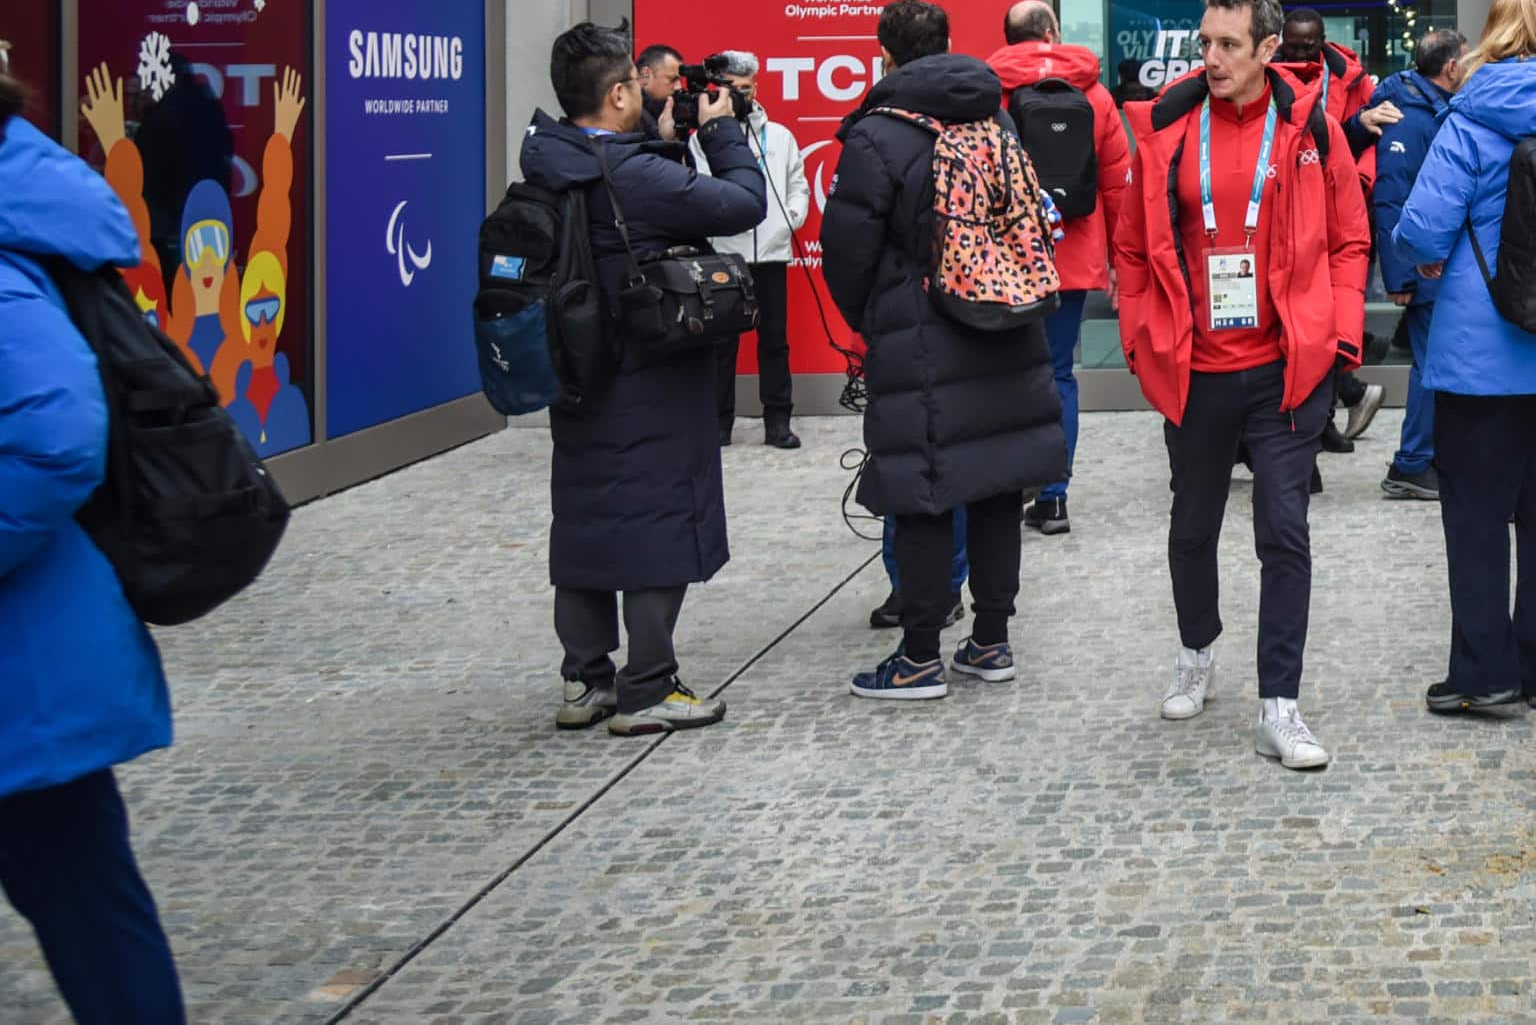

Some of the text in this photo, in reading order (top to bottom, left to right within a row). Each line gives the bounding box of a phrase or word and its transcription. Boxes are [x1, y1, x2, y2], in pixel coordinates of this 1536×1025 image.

[785, 4, 884, 18] Olympic Partne
[349, 29, 463, 80] SAMSUNG
[1154, 30, 1202, 58] IT'
[365, 99, 449, 114] WORLDWIDE PARTNER
